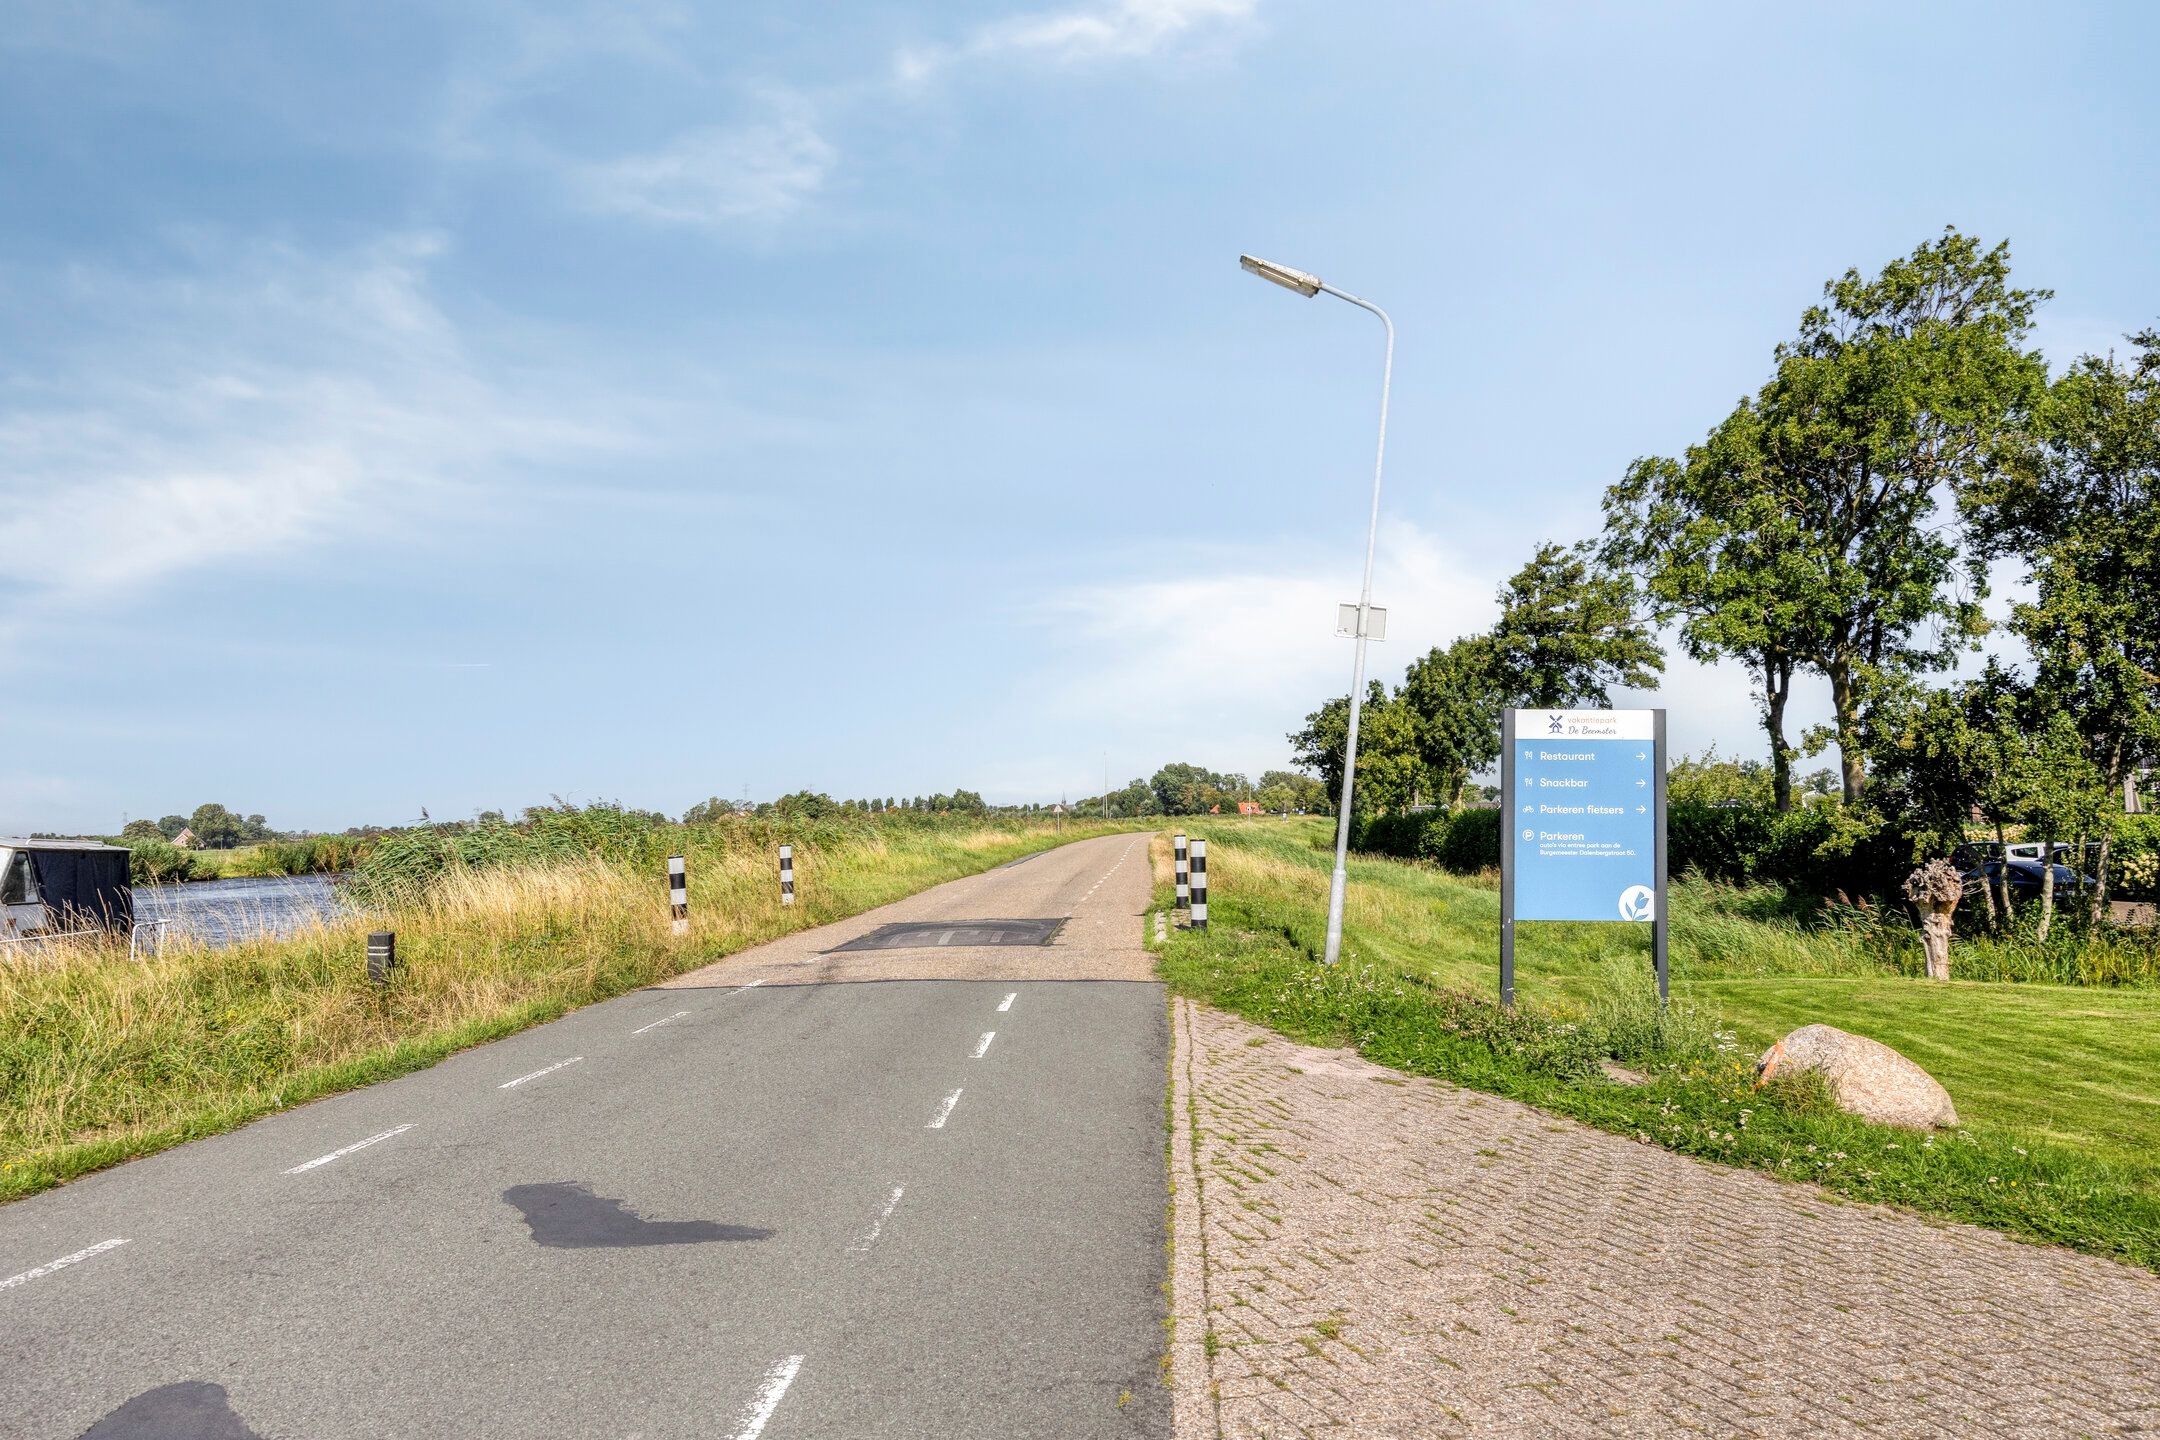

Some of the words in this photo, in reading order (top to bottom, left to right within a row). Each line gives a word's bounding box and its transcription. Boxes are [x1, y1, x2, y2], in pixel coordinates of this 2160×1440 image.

[1567, 716, 1617, 725] vakantiepark
[1568, 726, 1579, 735] De
[1581, 726, 1617, 735] Beemster
[1540, 752, 1595, 761] Restaurant
[1540, 778, 1588, 788] Snackbar
[1540, 805, 1584, 814] Parkeren
[1587, 804, 1624, 815] fietsers
[1540, 832, 1584, 841] Parkeren
[1586, 842, 1600, 850] park
